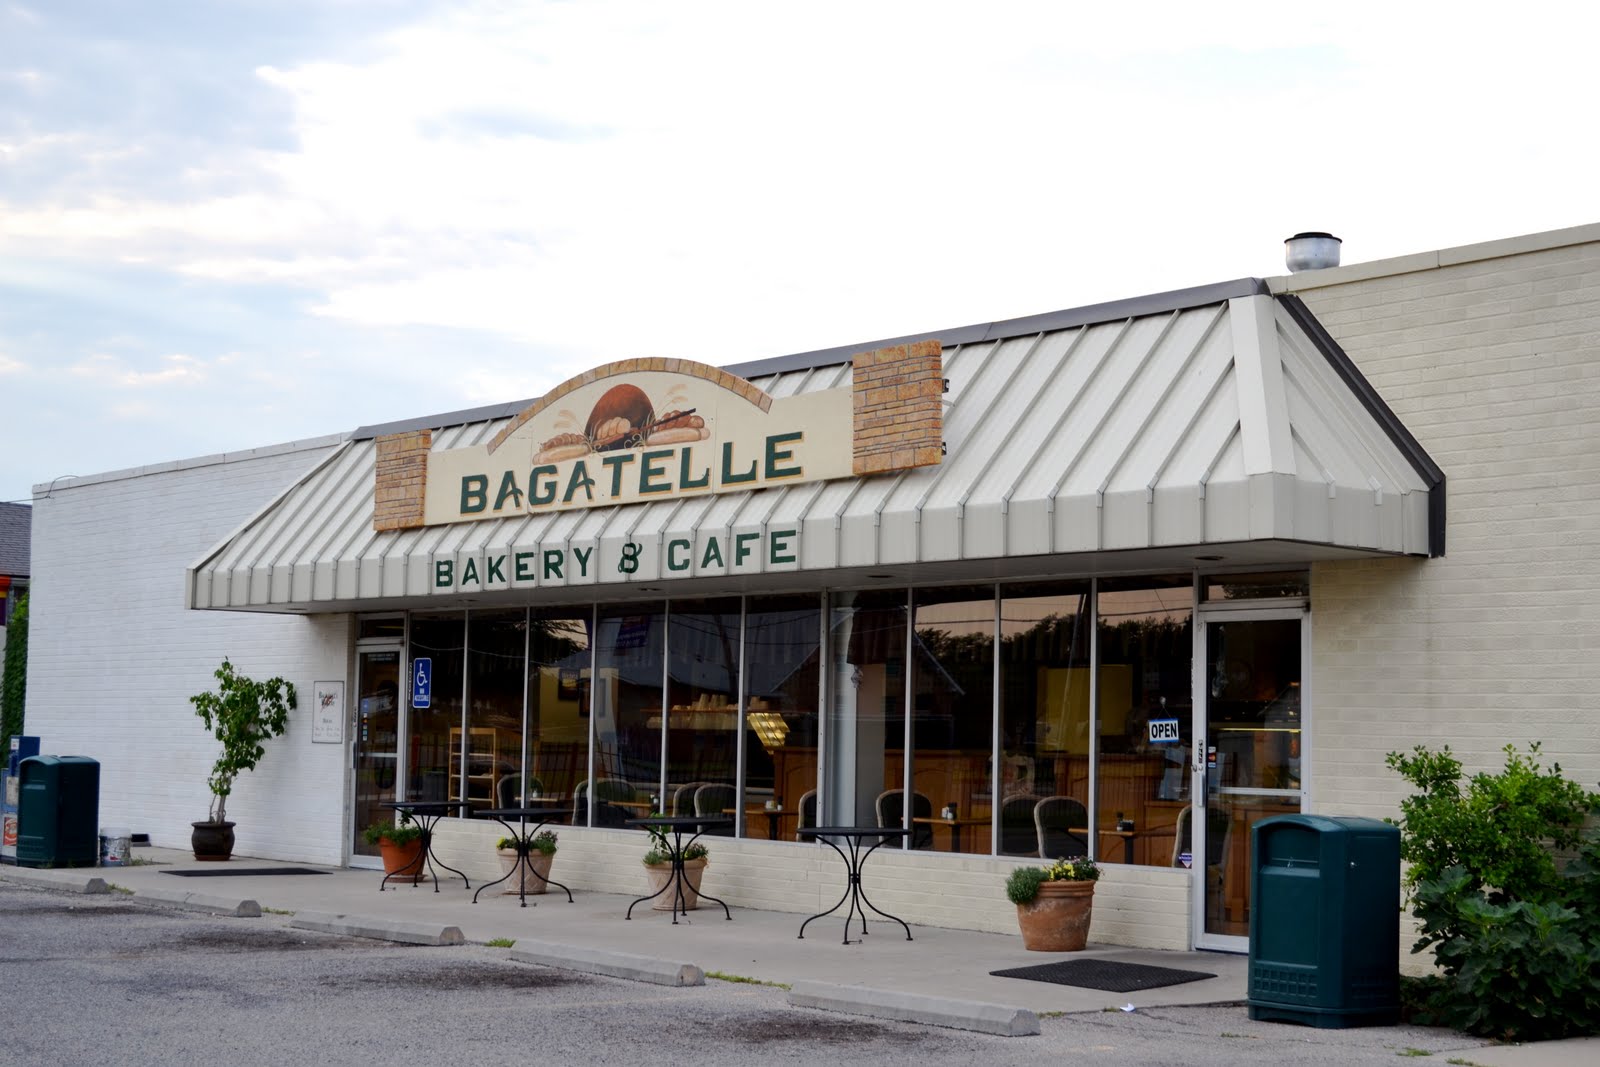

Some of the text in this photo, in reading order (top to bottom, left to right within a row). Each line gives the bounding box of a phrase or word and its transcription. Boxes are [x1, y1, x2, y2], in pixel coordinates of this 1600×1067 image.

[460, 431, 803, 514] BAGATELLE
[435, 530, 797, 588] BAKERY & CAFE
[1151, 723, 1177, 738] OPEN
